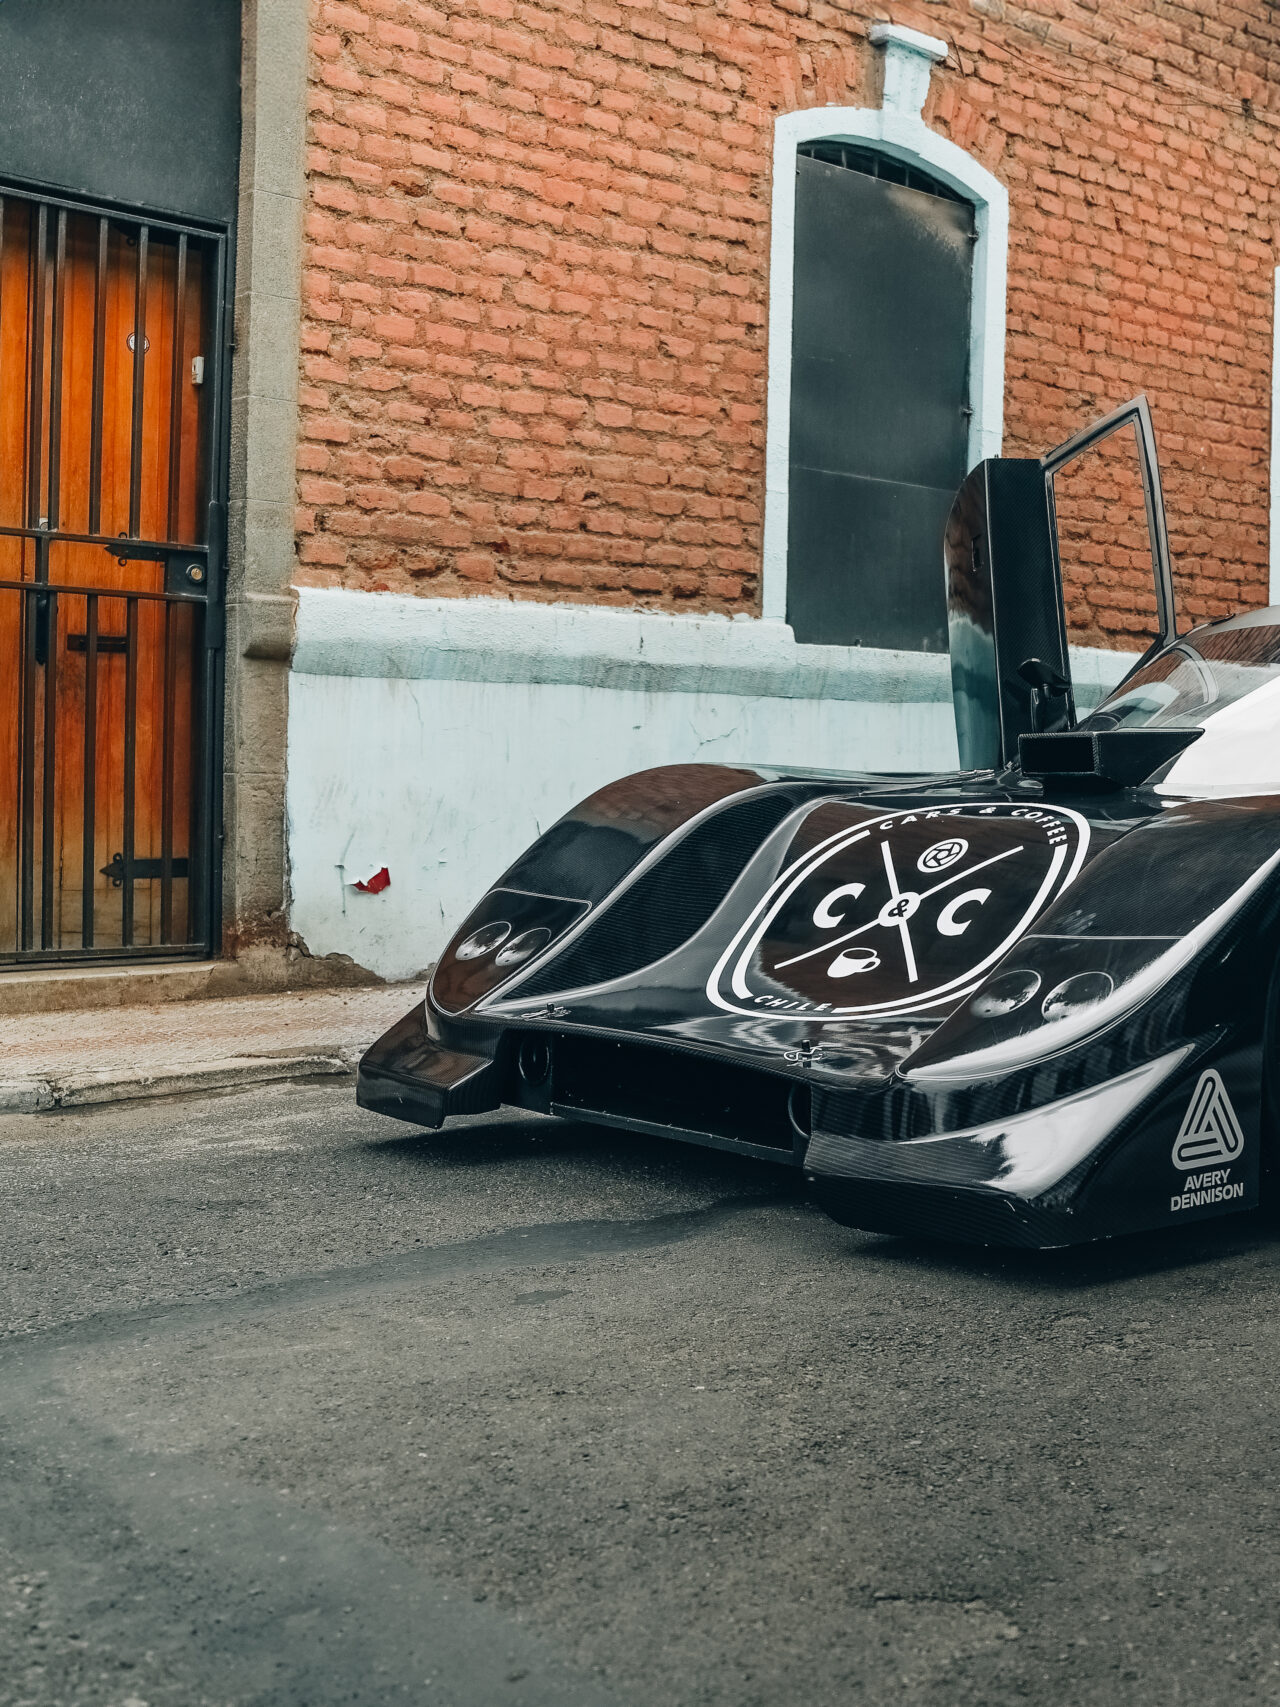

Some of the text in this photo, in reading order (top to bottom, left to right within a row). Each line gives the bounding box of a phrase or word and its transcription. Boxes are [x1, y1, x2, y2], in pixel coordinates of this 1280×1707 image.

[879, 806, 1067, 845] CARS & COFFEE
[812, 882, 992, 936] C & C
[754, 995, 832, 1011] CHILE
[1183, 1168, 1231, 1192] AVERY
[1170, 1182, 1244, 1212] DENNISON
